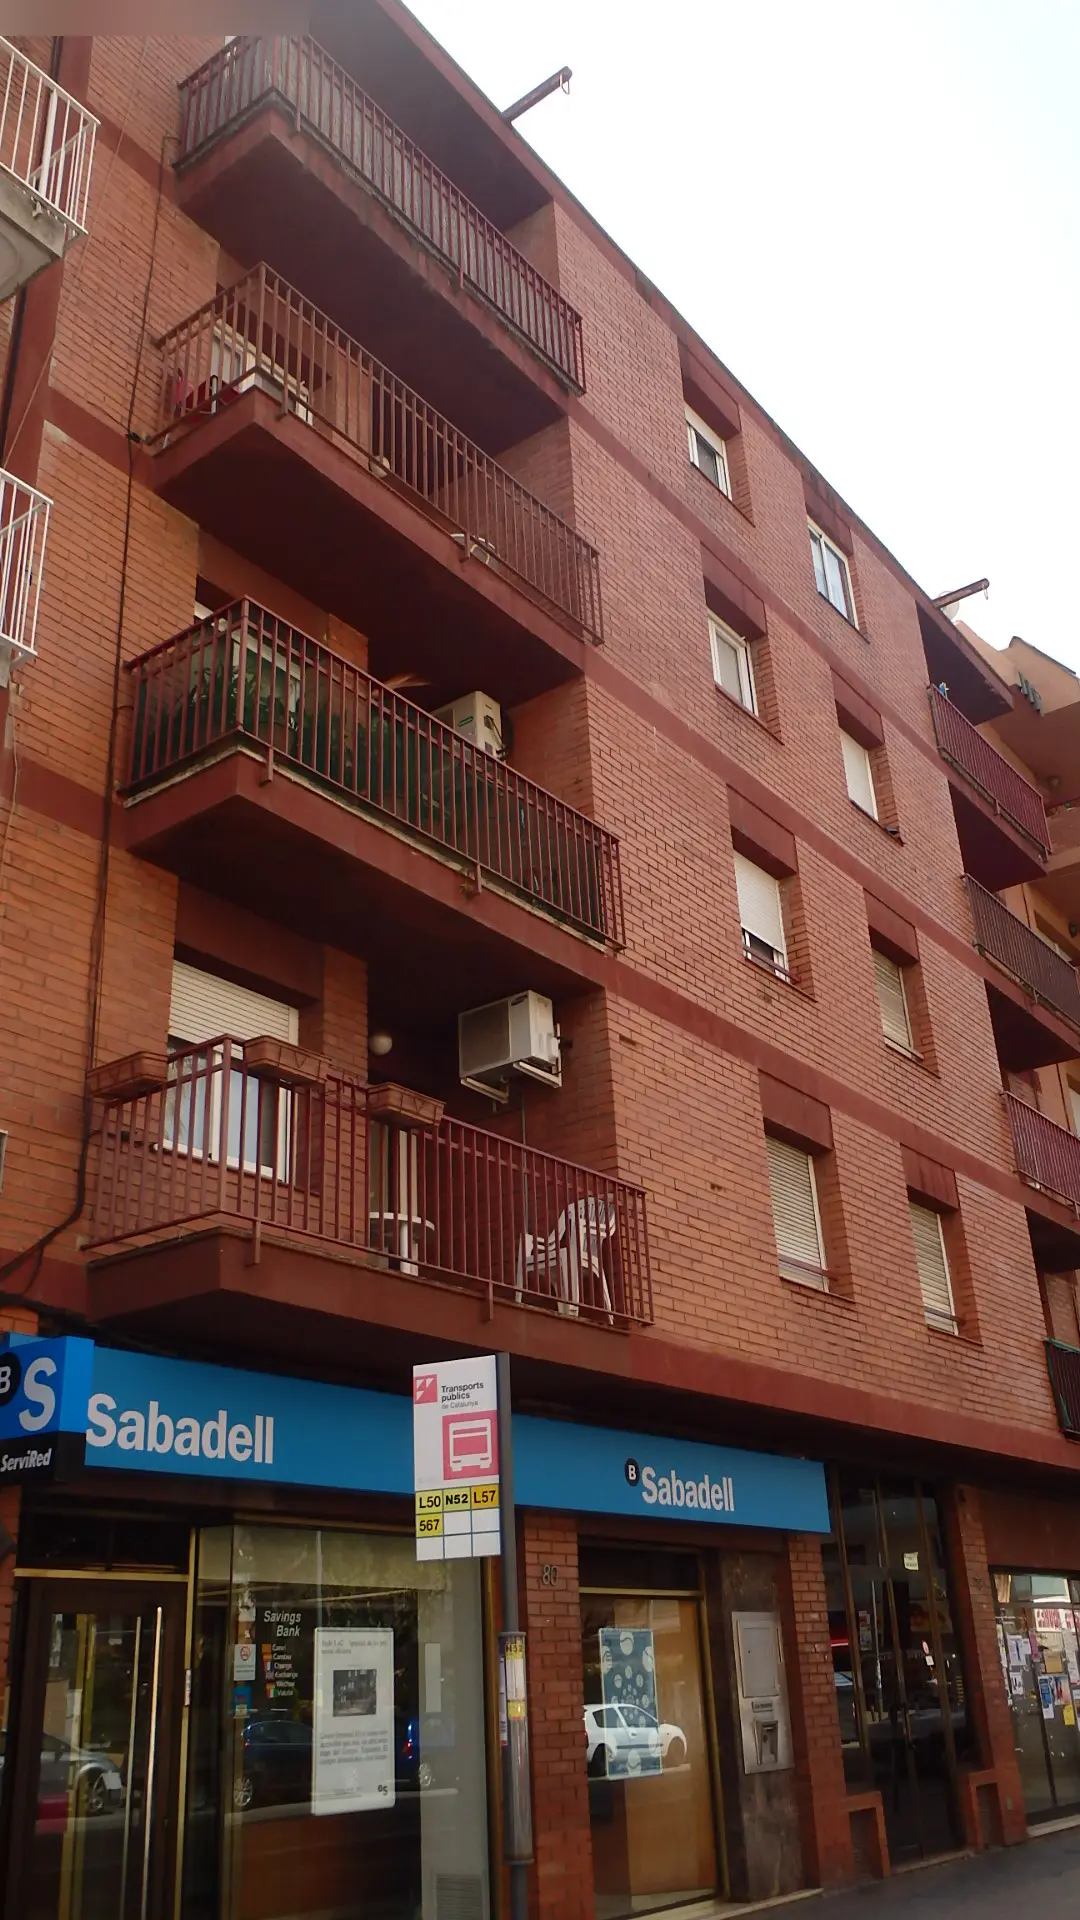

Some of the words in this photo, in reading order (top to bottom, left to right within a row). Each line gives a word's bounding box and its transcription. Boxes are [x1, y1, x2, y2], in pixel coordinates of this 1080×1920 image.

[441, 1382, 484, 1394] Transports
[441, 1392, 470, 1403] publics
[450, 1400, 479, 1409] Catalunya
[86, 1393, 274, 1464] Sabadell
[0, 1448, 52, 1472] ServiRed
[628, 1464, 637, 1480] B
[641, 1466, 735, 1512] Sabadell
[419, 1495, 441, 1508] L50
[445, 1493, 468, 1505] N52
[473, 1490, 496, 1504] L57
[419, 1519, 440, 1532] 567
[543, 1564, 558, 1586] 80
[263, 1610, 301, 1625] Savings
[276, 1625, 301, 1637] Bank
